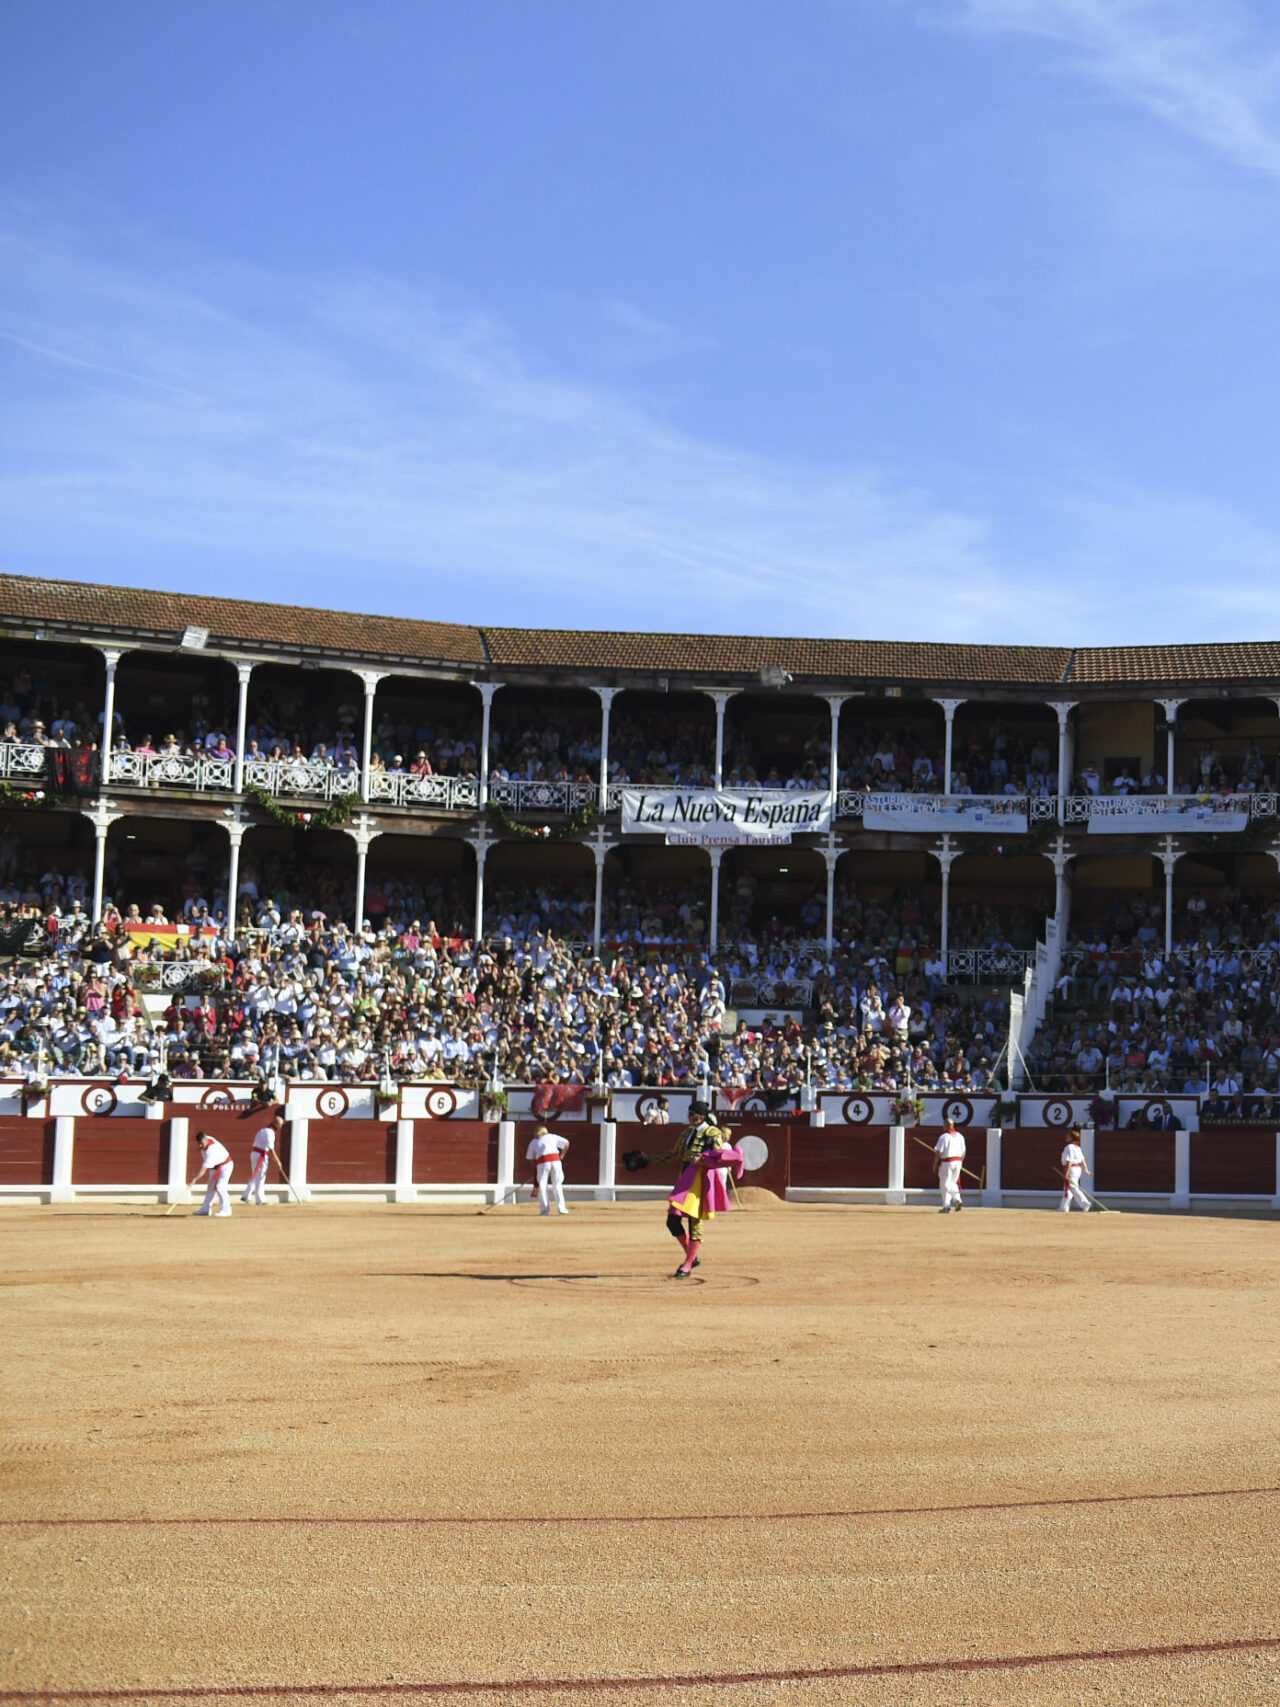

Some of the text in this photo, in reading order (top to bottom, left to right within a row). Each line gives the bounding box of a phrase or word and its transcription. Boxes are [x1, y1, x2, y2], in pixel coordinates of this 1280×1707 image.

[1091, 799, 1137, 808] ASTURIAS
[634, 795, 821, 828] La Nueva España
[668, 832, 790, 844] Club Prensa Taurina
[94, 1094, 103, 1107] 6
[328, 1097, 336, 1110] 6
[437, 1097, 445, 1110] 6
[853, 1104, 862, 1116] 4
[952, 1105, 962, 1118] 4
[1053, 1107, 1062, 1120] 2
